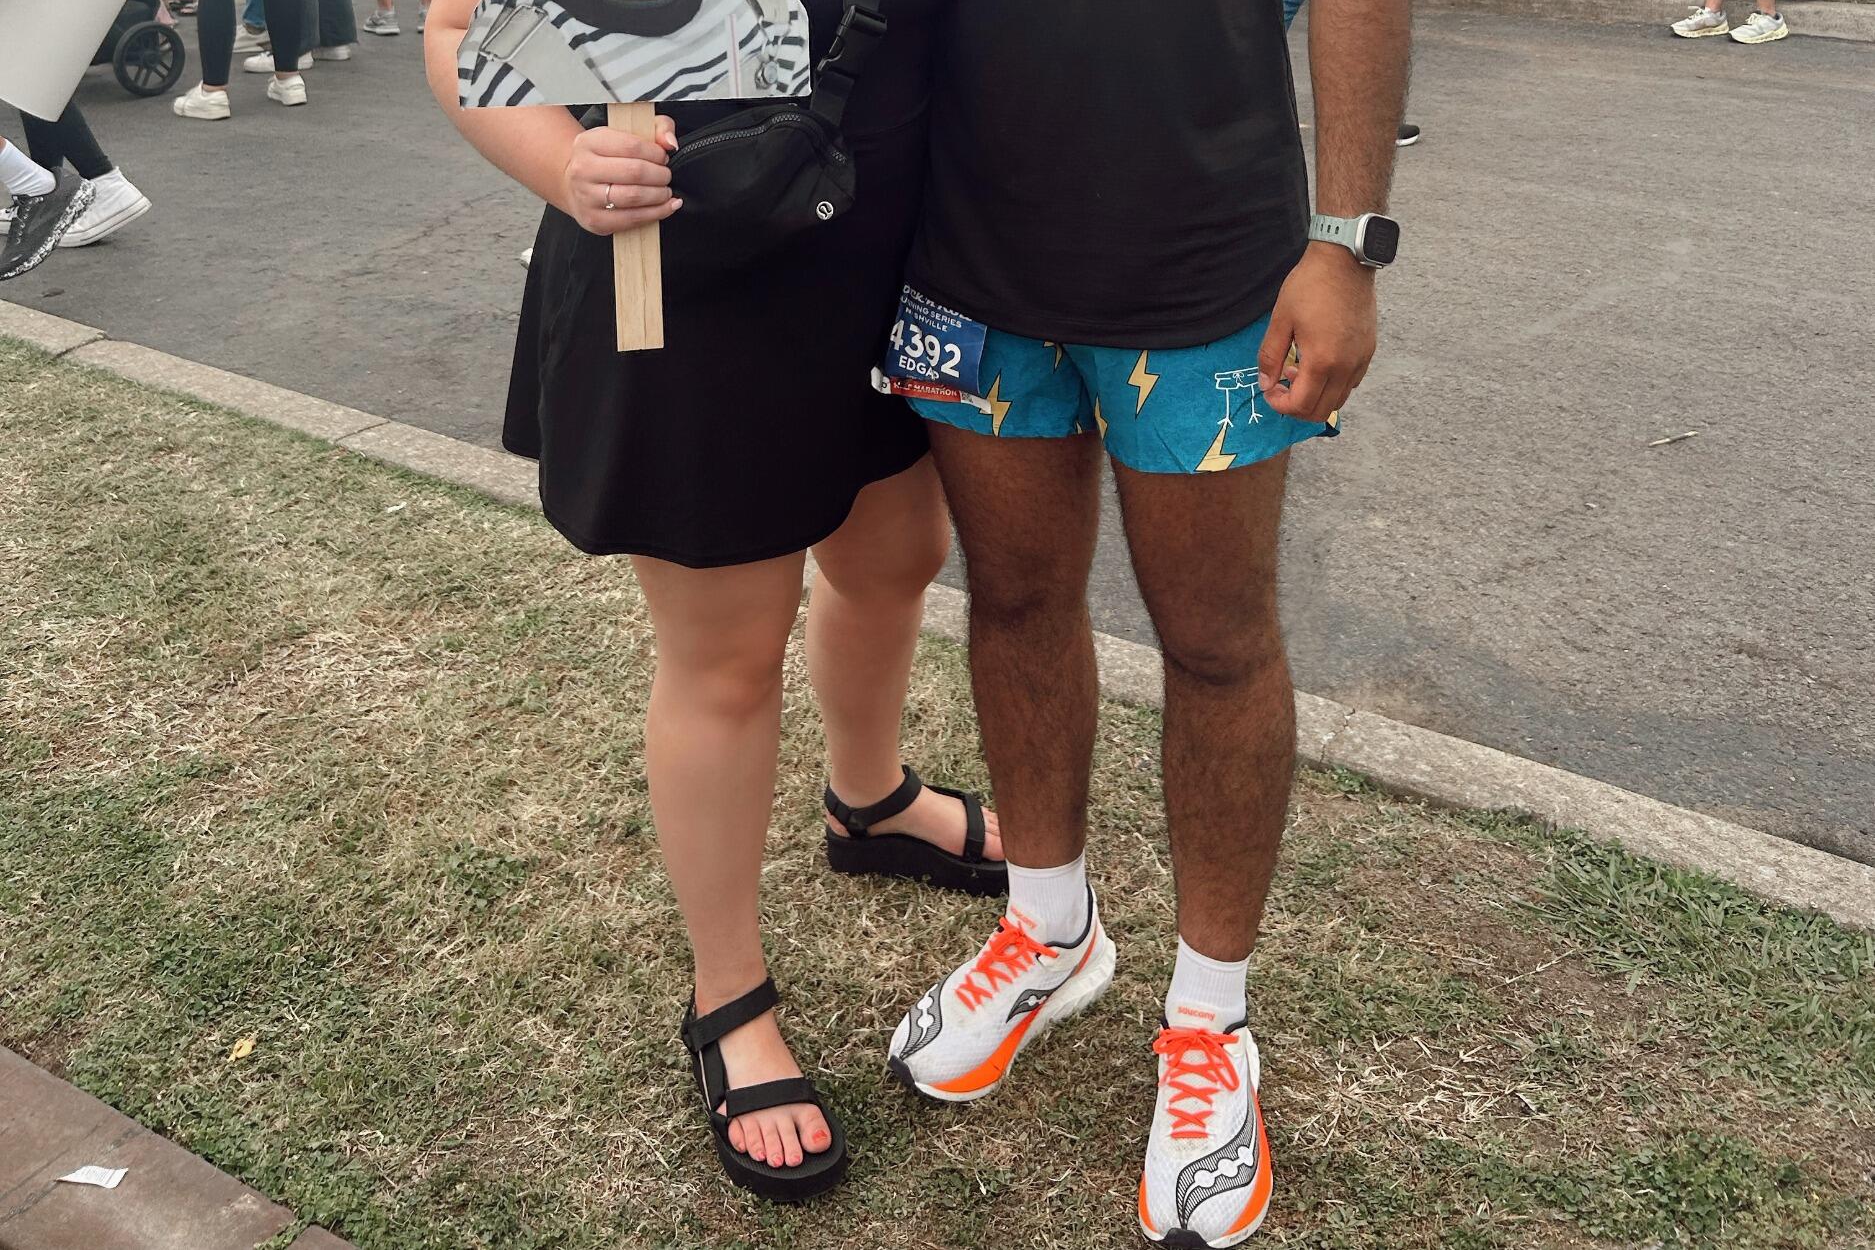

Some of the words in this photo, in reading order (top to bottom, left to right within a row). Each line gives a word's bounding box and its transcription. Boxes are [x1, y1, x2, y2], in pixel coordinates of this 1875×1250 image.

[905, 307, 948, 332] NSHVILLE
[930, 311, 962, 329] SERIES
[890, 319, 961, 378] 4392
[1177, 1006, 1216, 1021] saucony
